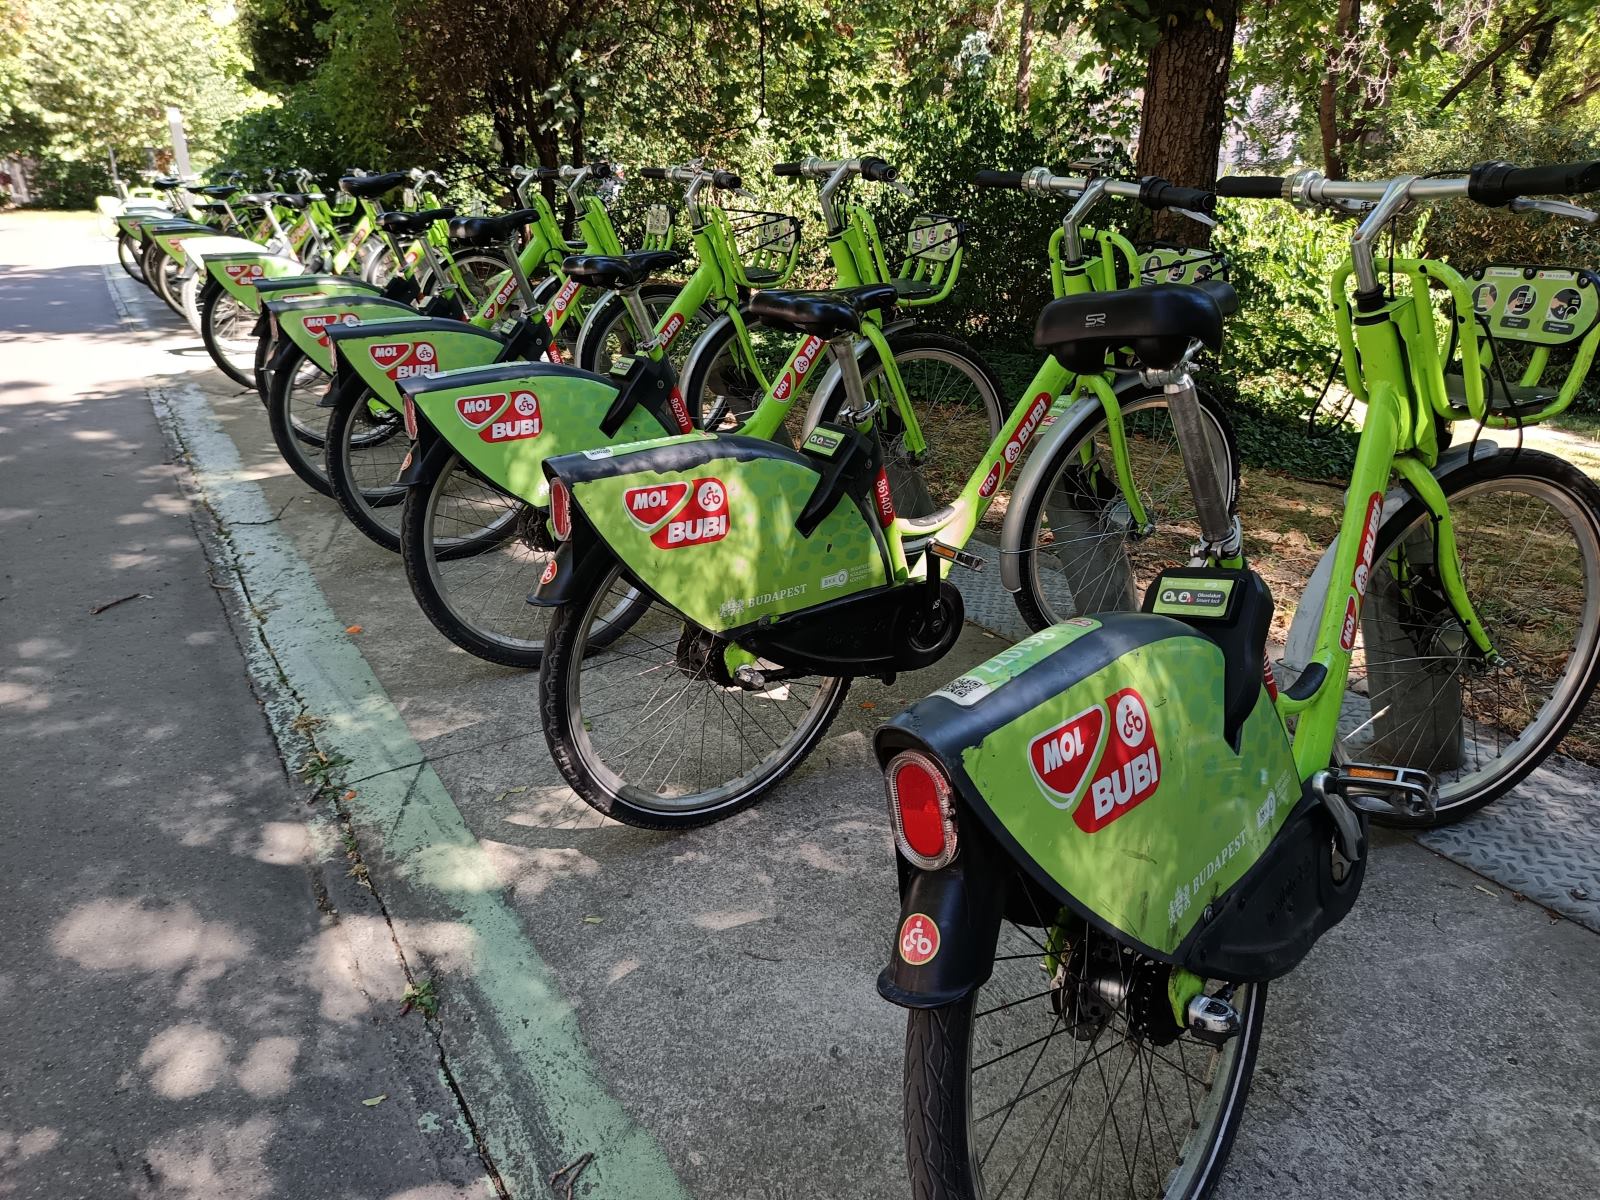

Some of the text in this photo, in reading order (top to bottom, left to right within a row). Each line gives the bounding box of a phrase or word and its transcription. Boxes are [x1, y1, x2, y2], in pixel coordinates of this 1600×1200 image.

[503, 277, 518, 297] BUB
[562, 280, 579, 301] BUB
[306, 317, 328, 327] MOL
[659, 316, 681, 346] BUBI
[375, 346, 398, 357] MOL
[550, 350, 562, 365] 860
[804, 335, 824, 360] BU
[396, 363, 437, 379] BUBI
[775, 380, 789, 399] MOL
[463, 399, 491, 414] MOL
[669, 397, 689, 428] 862201
[491, 418, 540, 439] BUBI
[1018, 398, 1047, 445] BUBI
[982, 472, 997, 495] MOL
[632, 489, 669, 511] MOL
[876, 478, 893, 516] 861402
[667, 514, 727, 544] BUBI
[1362, 498, 1382, 568] BUBI
[748, 583, 808, 608] BUDAPEST
[1343, 613, 1355, 647] MOL
[1043, 726, 1085, 775] MOL
[1091, 746, 1159, 821] BUBI
[1193, 830, 1247, 896] BUDAPEST
